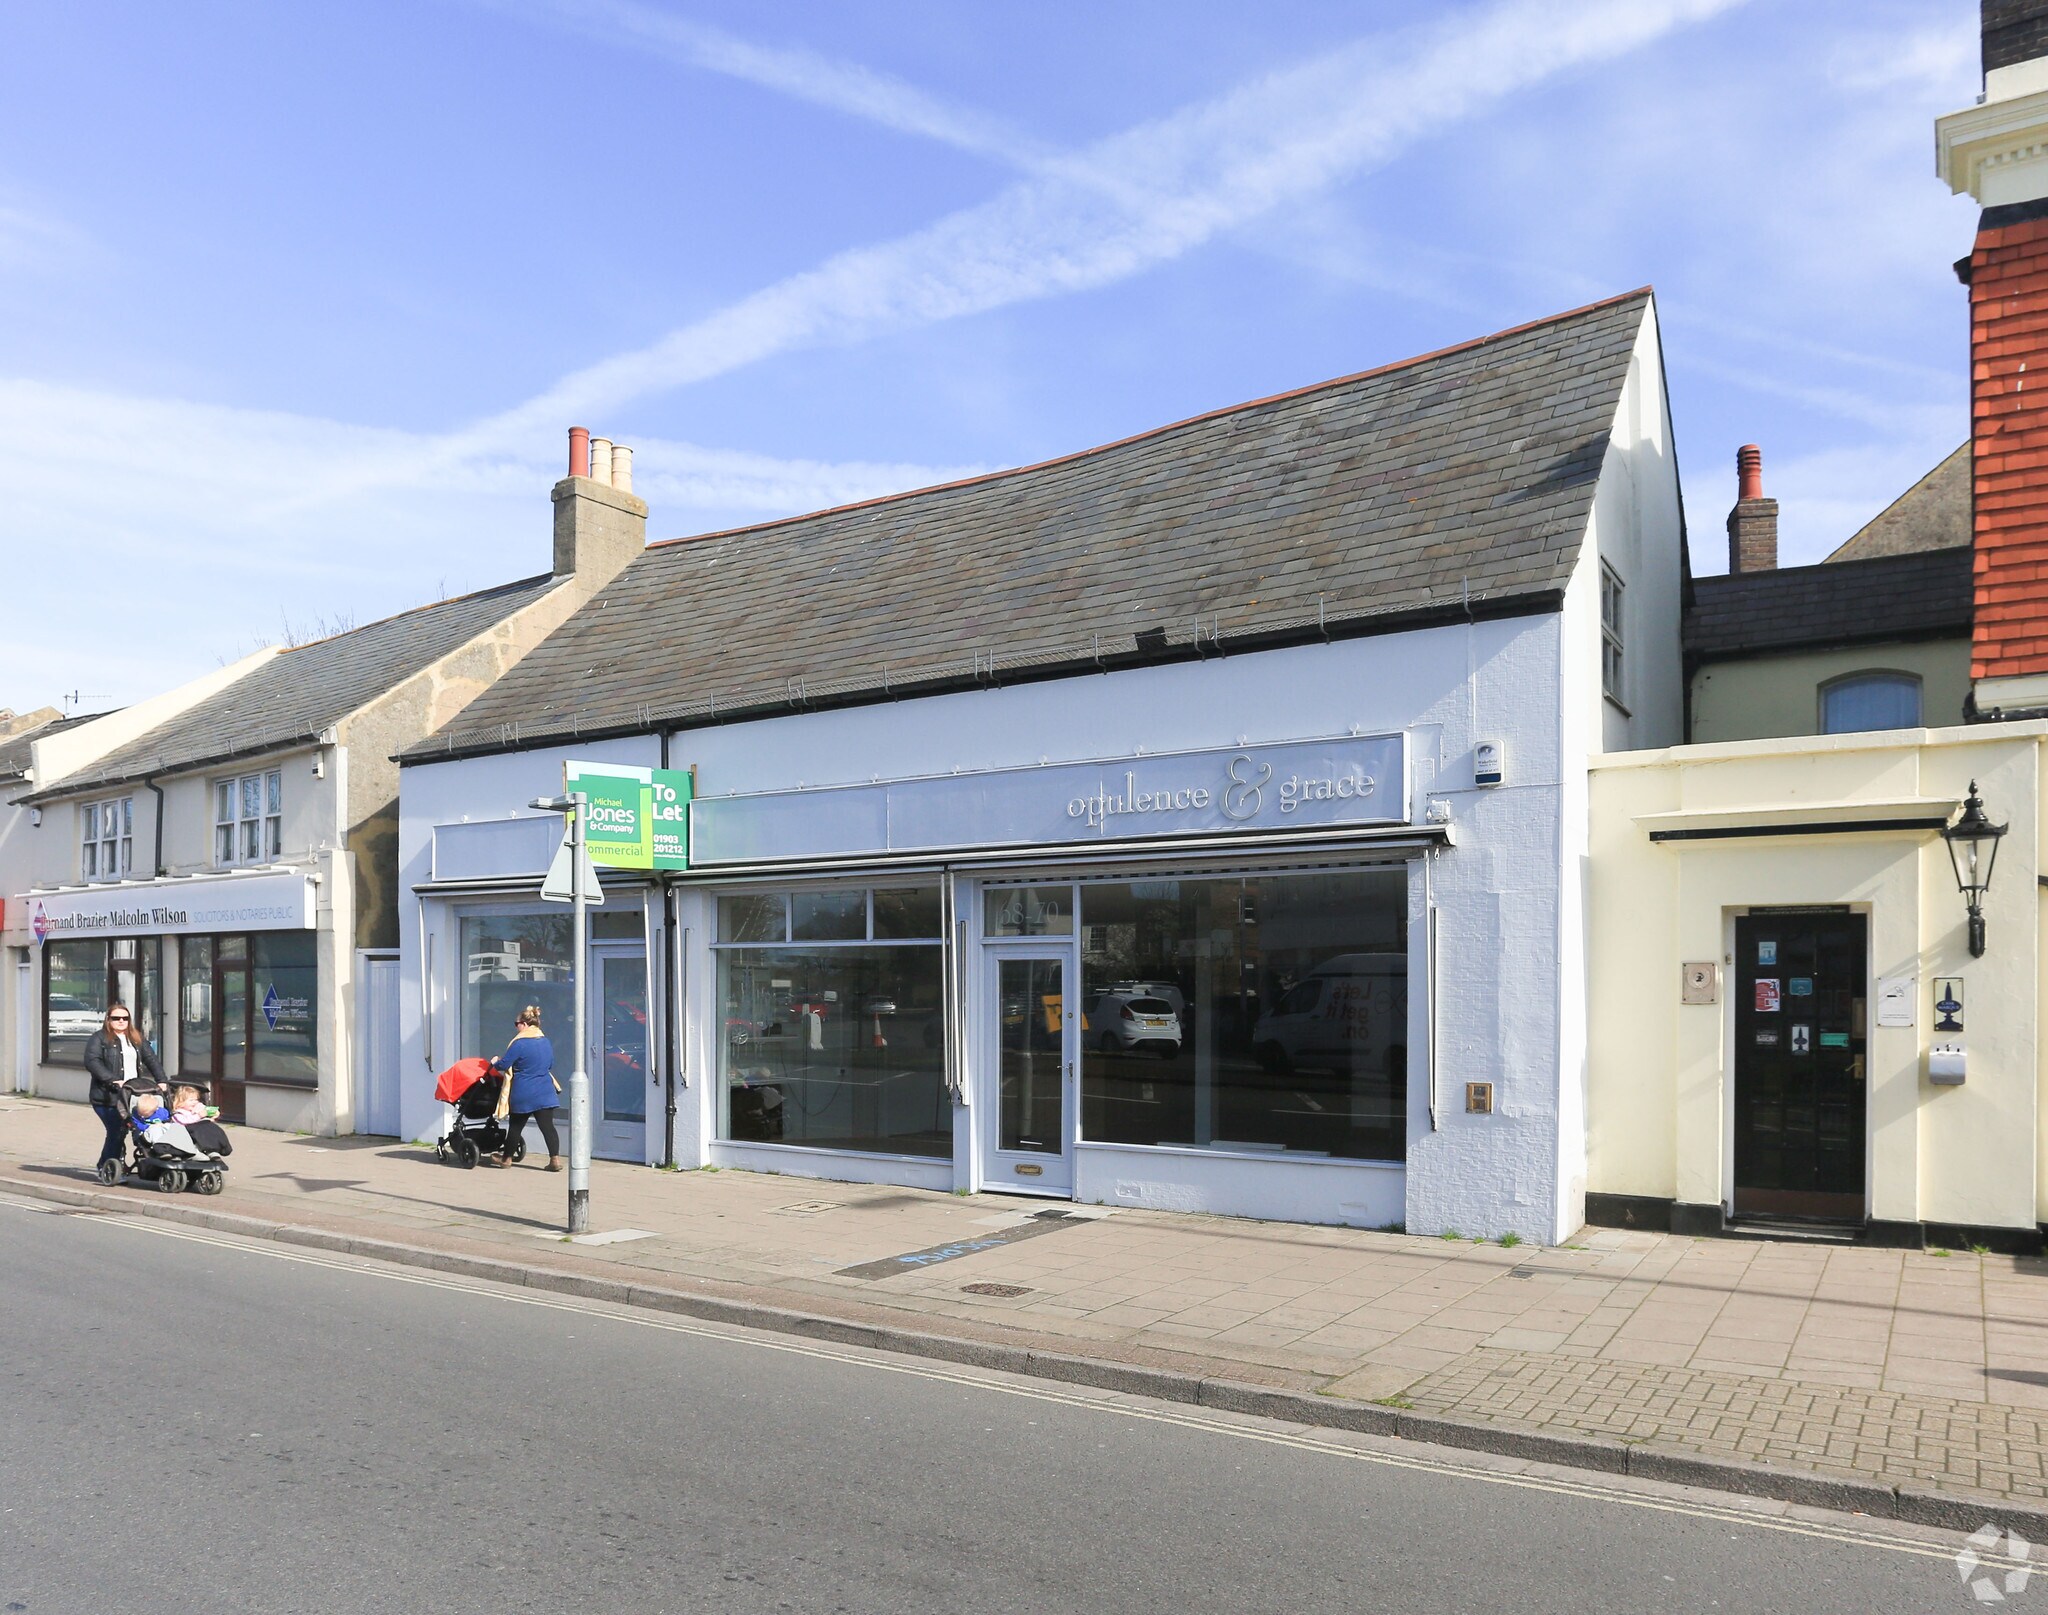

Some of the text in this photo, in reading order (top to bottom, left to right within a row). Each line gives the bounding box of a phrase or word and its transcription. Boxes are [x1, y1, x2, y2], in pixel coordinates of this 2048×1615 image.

[652, 784, 676, 802] To
[1067, 753, 1376, 828] opulence & grace
[594, 798, 622, 806] Michael
[585, 803, 635, 823] Jones
[653, 803, 683, 821] Let
[589, 820, 633, 834] & Company
[653, 834, 678, 843] 01903
[587, 845, 643, 856] ommercial
[654, 844, 683, 853] 201212
[76, 912, 108, 929] Brazier
[109, 909, 150, 927] Malcolm
[151, 906, 188, 925] Wilson
[999, 900, 1059, 926] 68-70
